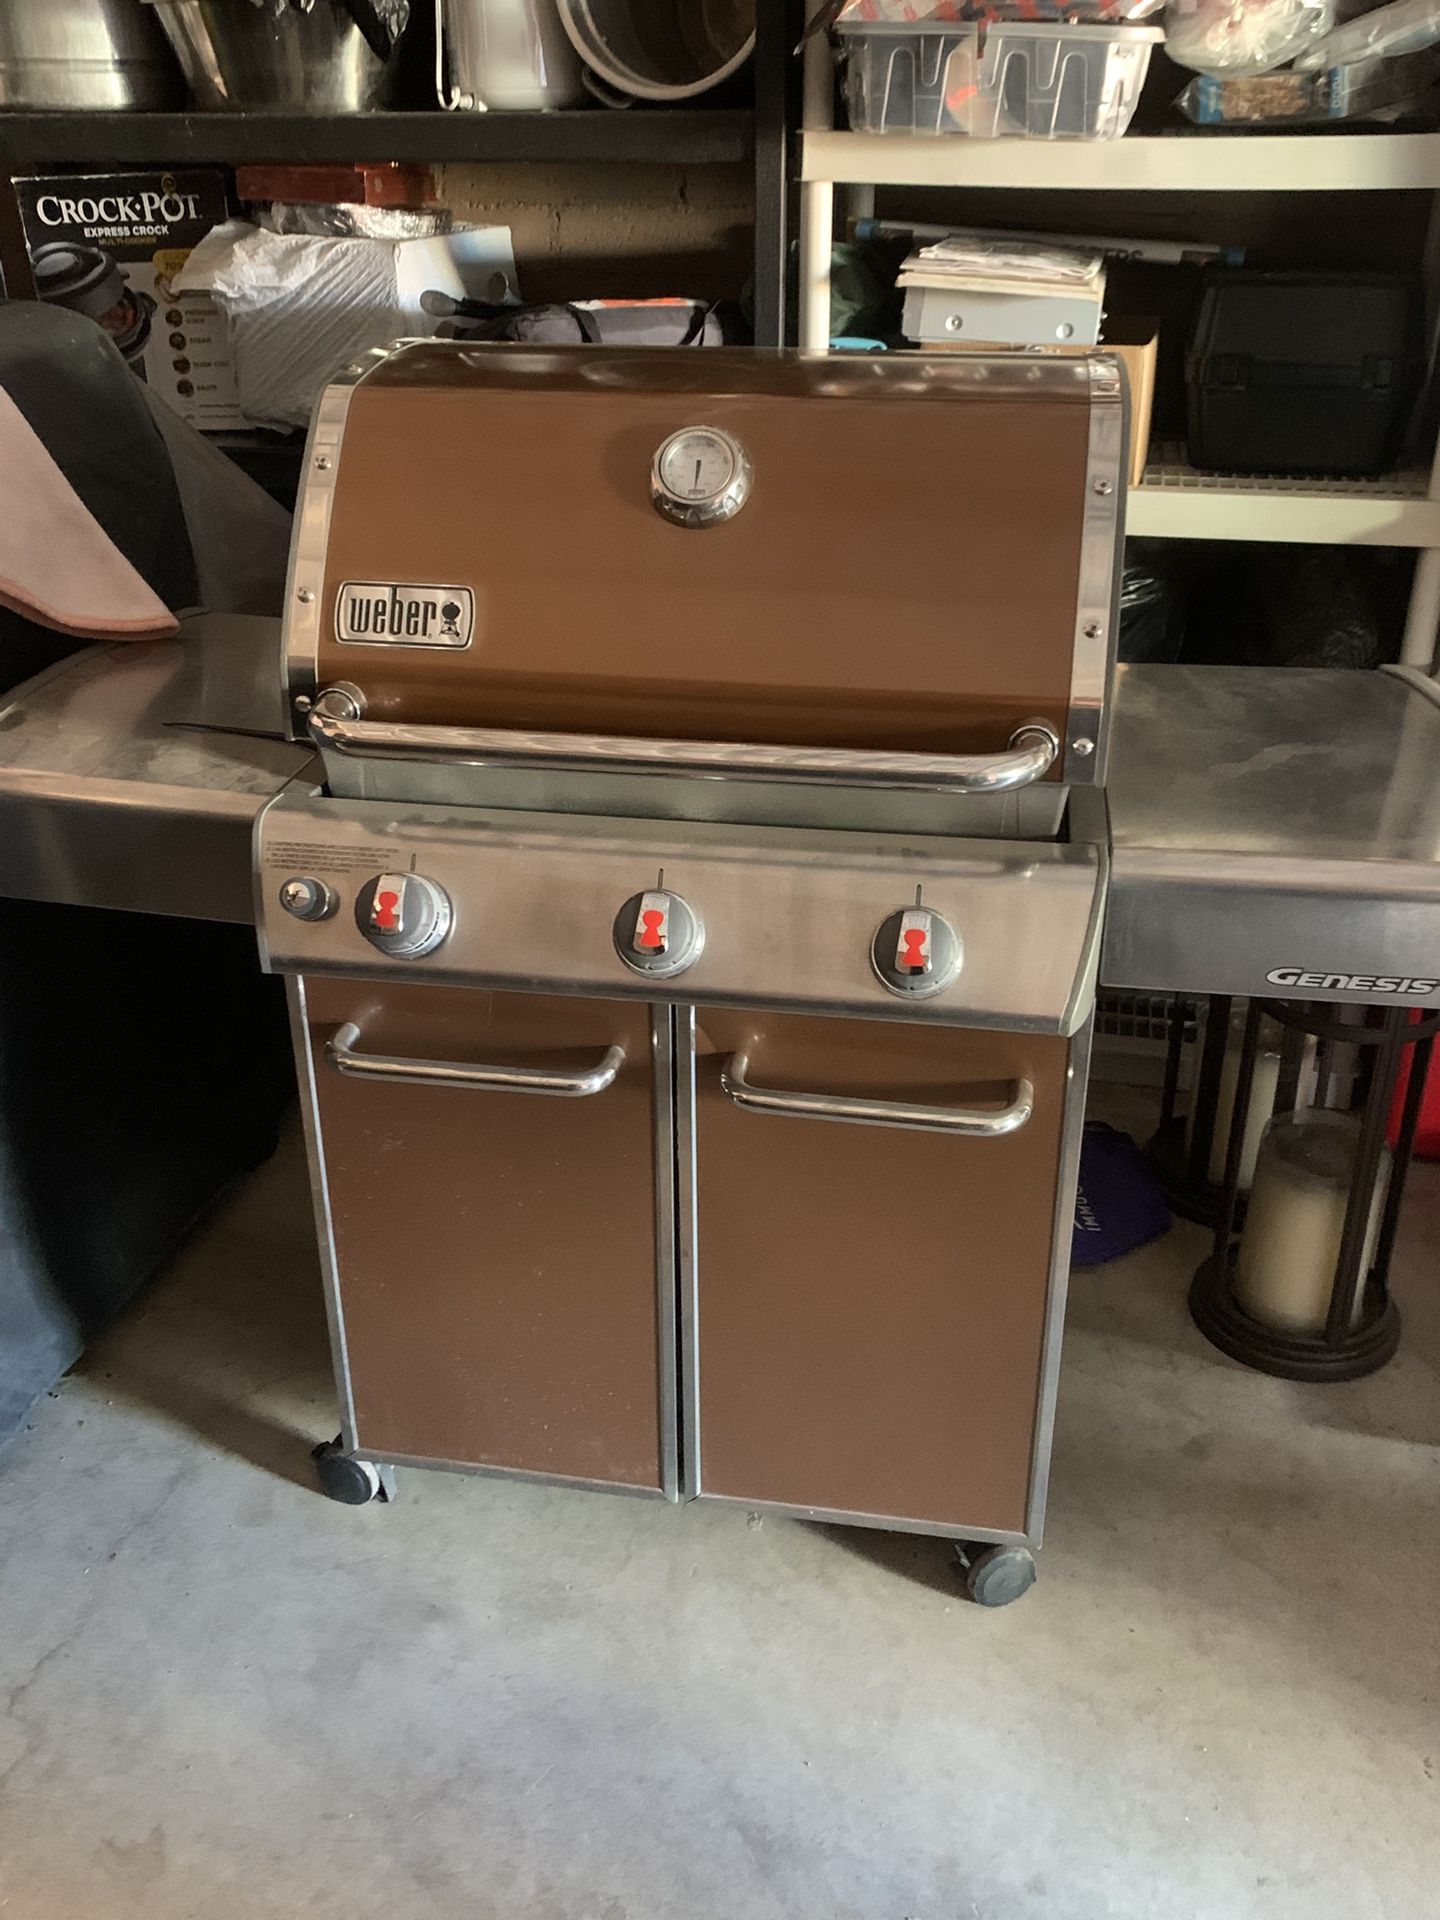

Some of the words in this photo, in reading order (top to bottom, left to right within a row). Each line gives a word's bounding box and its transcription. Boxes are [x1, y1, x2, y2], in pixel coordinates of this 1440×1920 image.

[84, 226, 130, 238] EXPRESS
[132, 225, 169, 236] CROCK
[350, 586, 437, 637] weber
[1265, 967, 1439, 995] GENESIS
